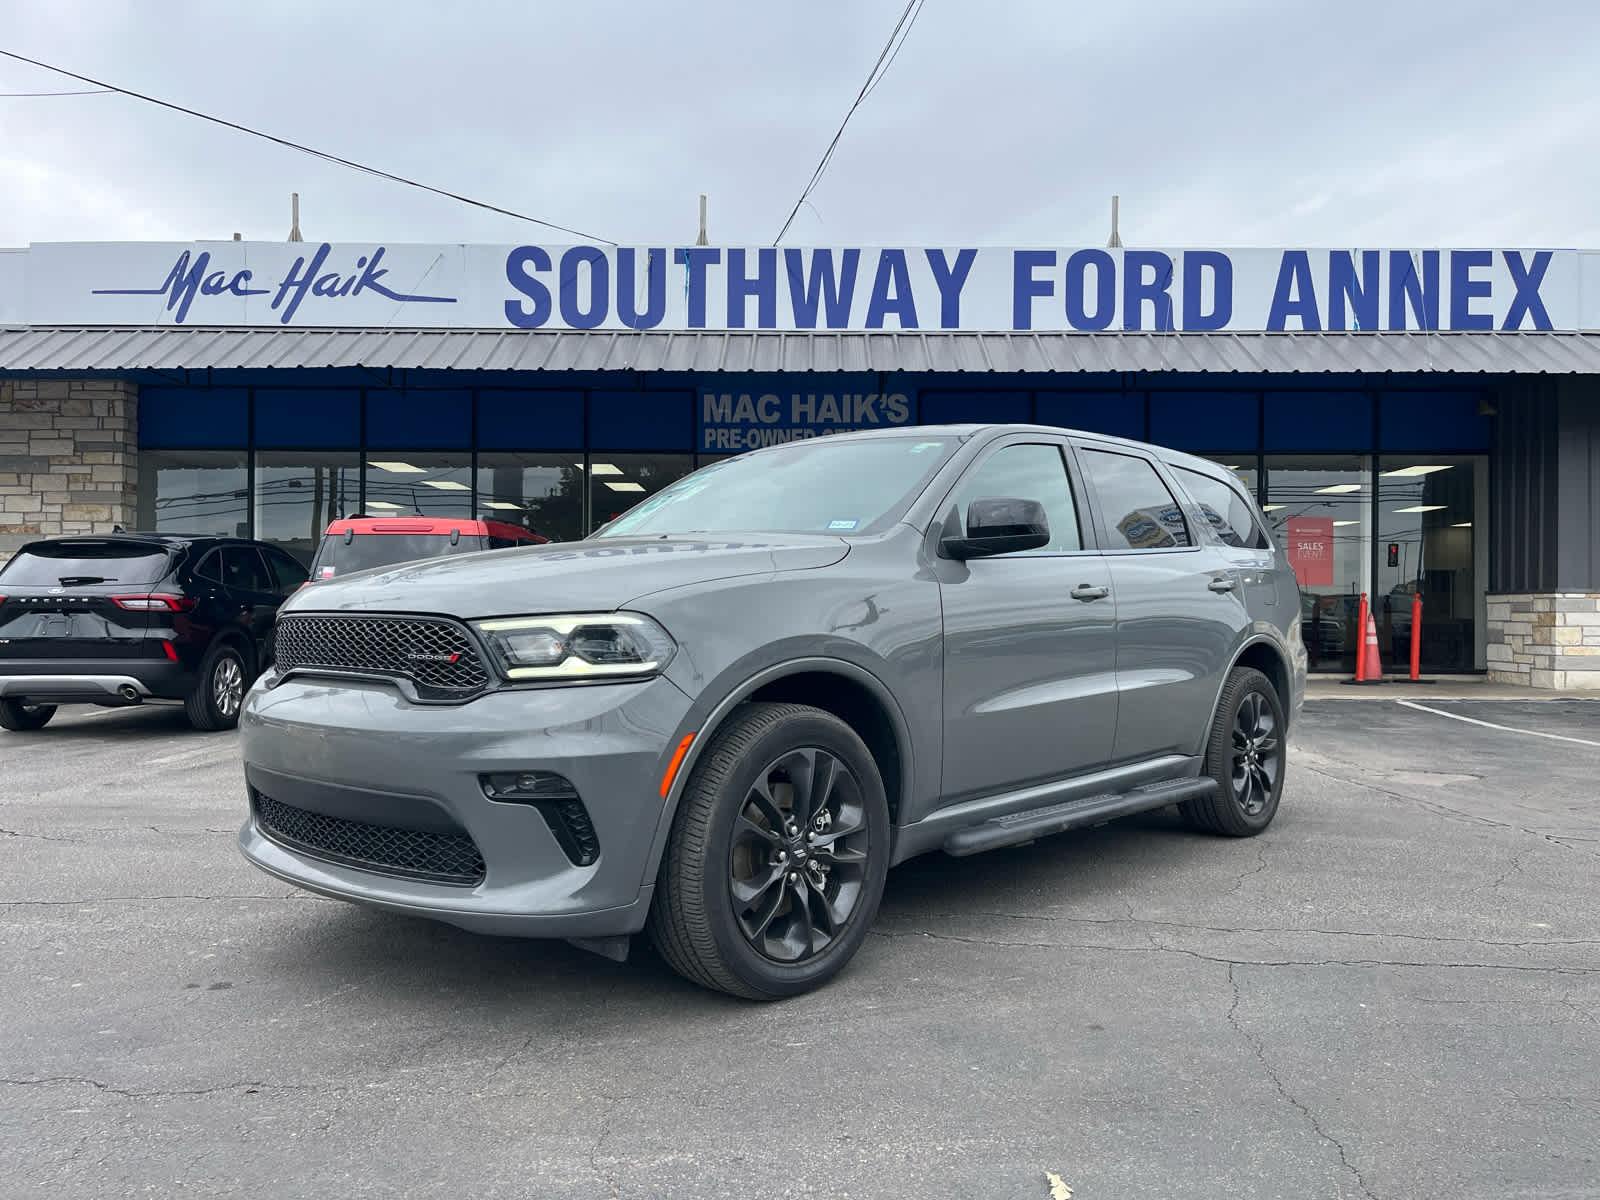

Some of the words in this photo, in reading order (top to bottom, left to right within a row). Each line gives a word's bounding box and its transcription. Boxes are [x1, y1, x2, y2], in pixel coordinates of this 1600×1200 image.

[92, 249, 271, 324] Mac
[270, 242, 457, 324] Haik
[503, 245, 978, 330] SOUTHWAY
[1012, 248, 1233, 331] FORD
[1266, 250, 1554, 331] ANNEX
[702, 393, 782, 424] MAC
[791, 392, 910, 424] HAIK'S
[1297, 542, 1324, 551] SALES
